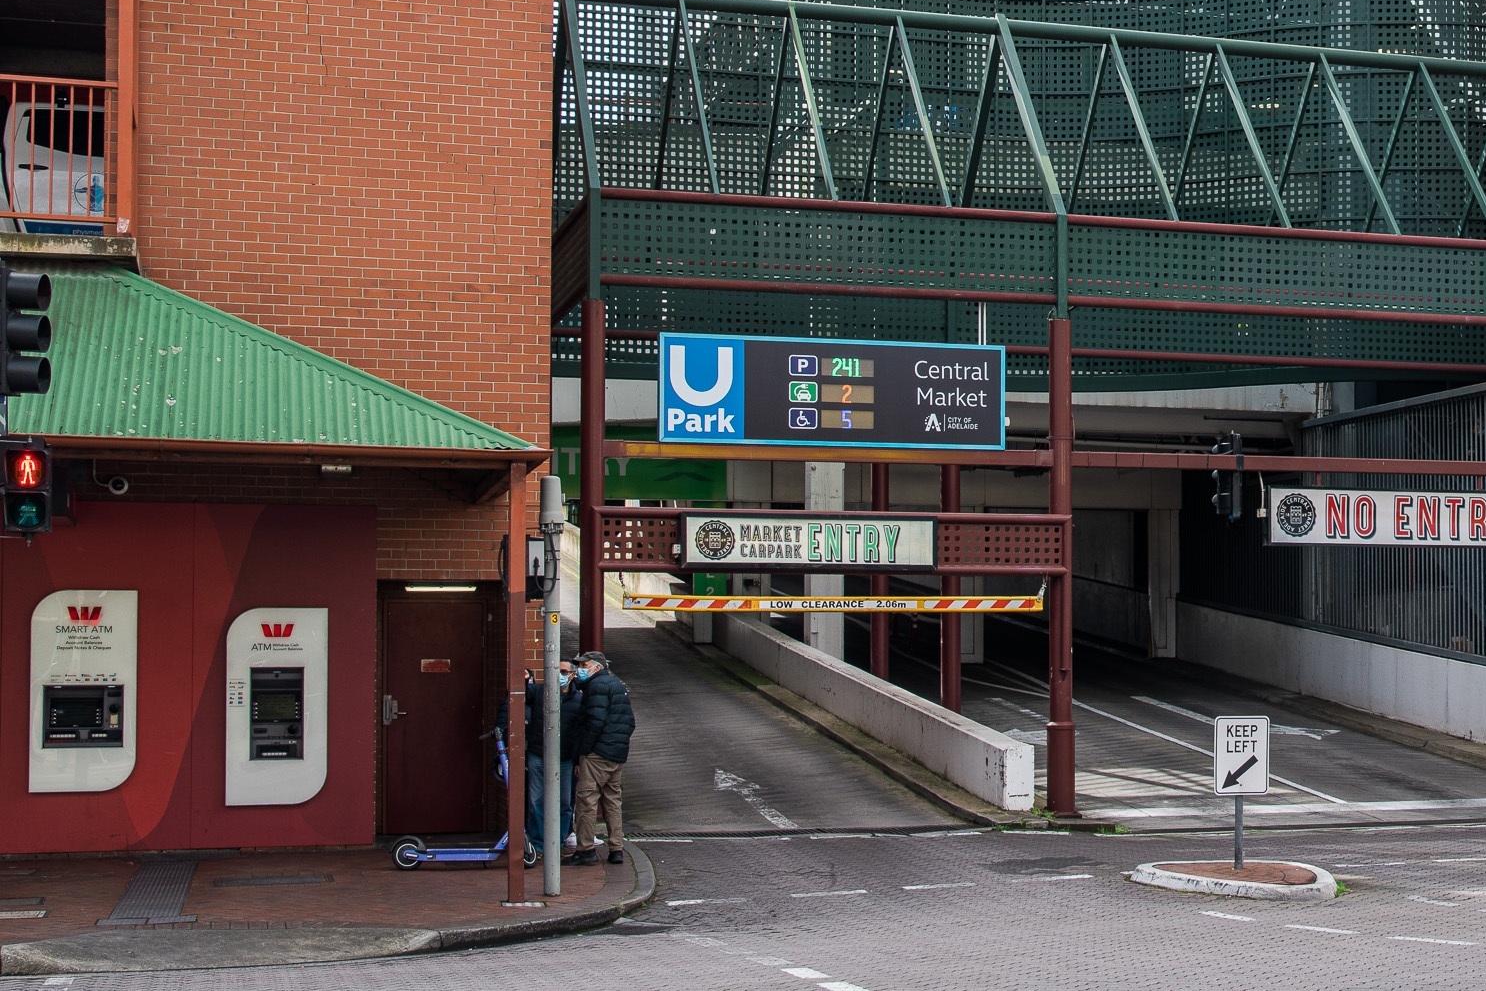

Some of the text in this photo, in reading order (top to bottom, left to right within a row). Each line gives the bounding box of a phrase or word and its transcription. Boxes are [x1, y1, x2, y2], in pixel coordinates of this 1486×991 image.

[669, 344, 733, 406] U
[831, 357, 862, 378] 241
[914, 360, 989, 381] Central
[841, 384, 852, 404] 2
[917, 387, 987, 408] Market
[667, 407, 735, 433] Park
[841, 410, 852, 429] 5
[1325, 493, 1376, 539] NO
[740, 524, 802, 543] MARKET
[808, 522, 901, 563] ENTRY
[740, 543, 802, 559] CARPARK
[770, 600, 906, 609] LOW CLEARANCE 2.06m
[551, 613, 558, 624] 3
[55, 625, 113, 633] SMART ATM
[251, 643, 272, 651] ATM
[1226, 725, 1258, 737] KEEP
[1226, 740, 1258, 753] LEFT
